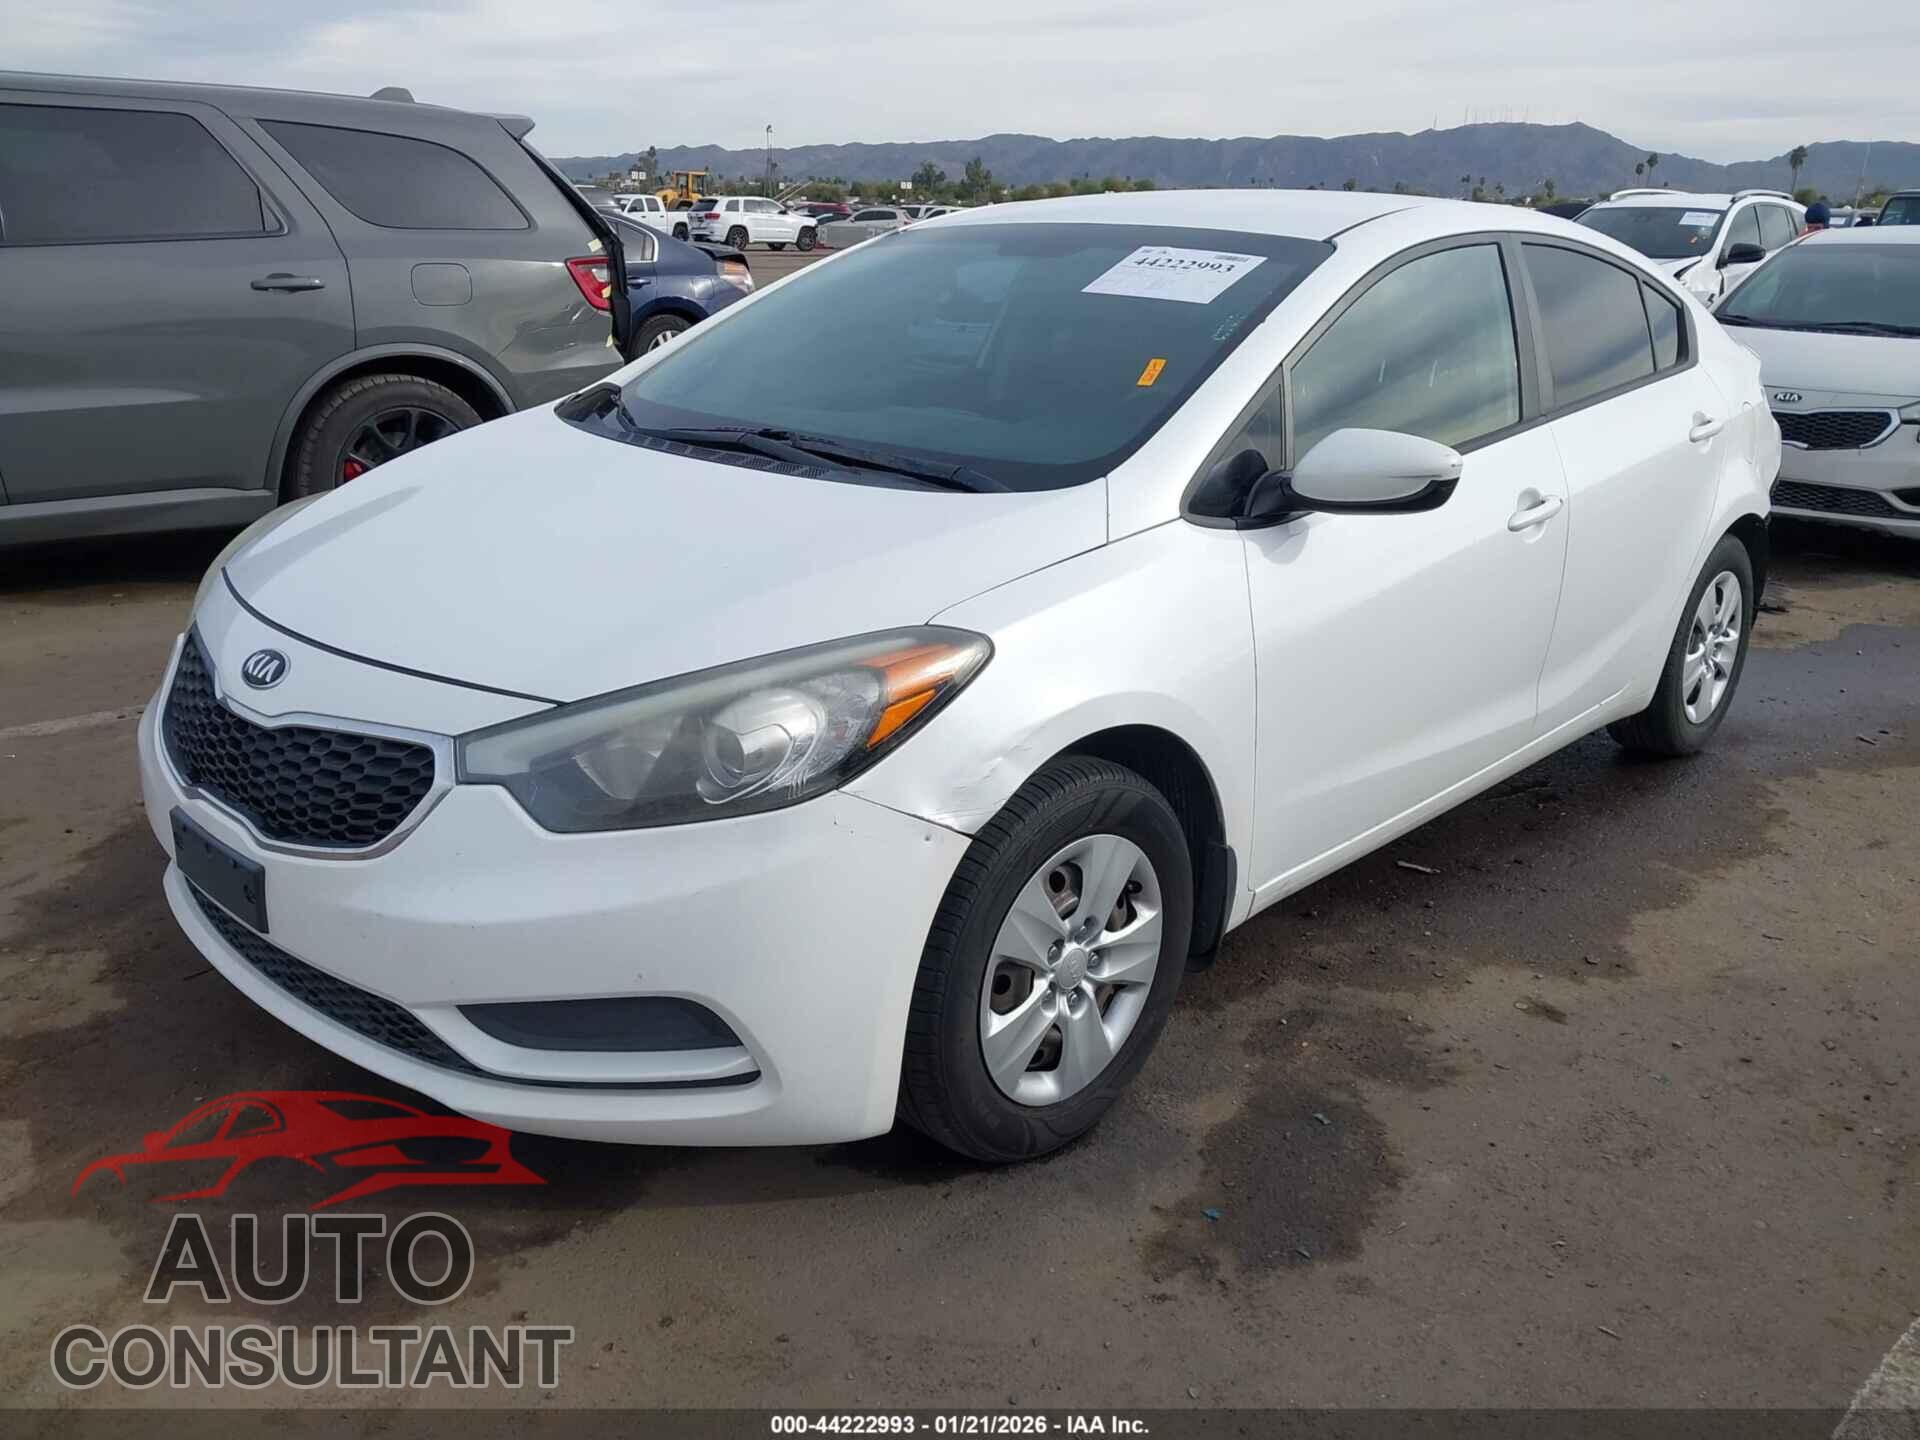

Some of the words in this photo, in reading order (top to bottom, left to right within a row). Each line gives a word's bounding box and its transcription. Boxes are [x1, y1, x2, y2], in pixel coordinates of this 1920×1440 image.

[1132, 256, 1236, 273] 44222993
[1775, 392, 1801, 402] KIA
[243, 653, 283, 684] KIA
